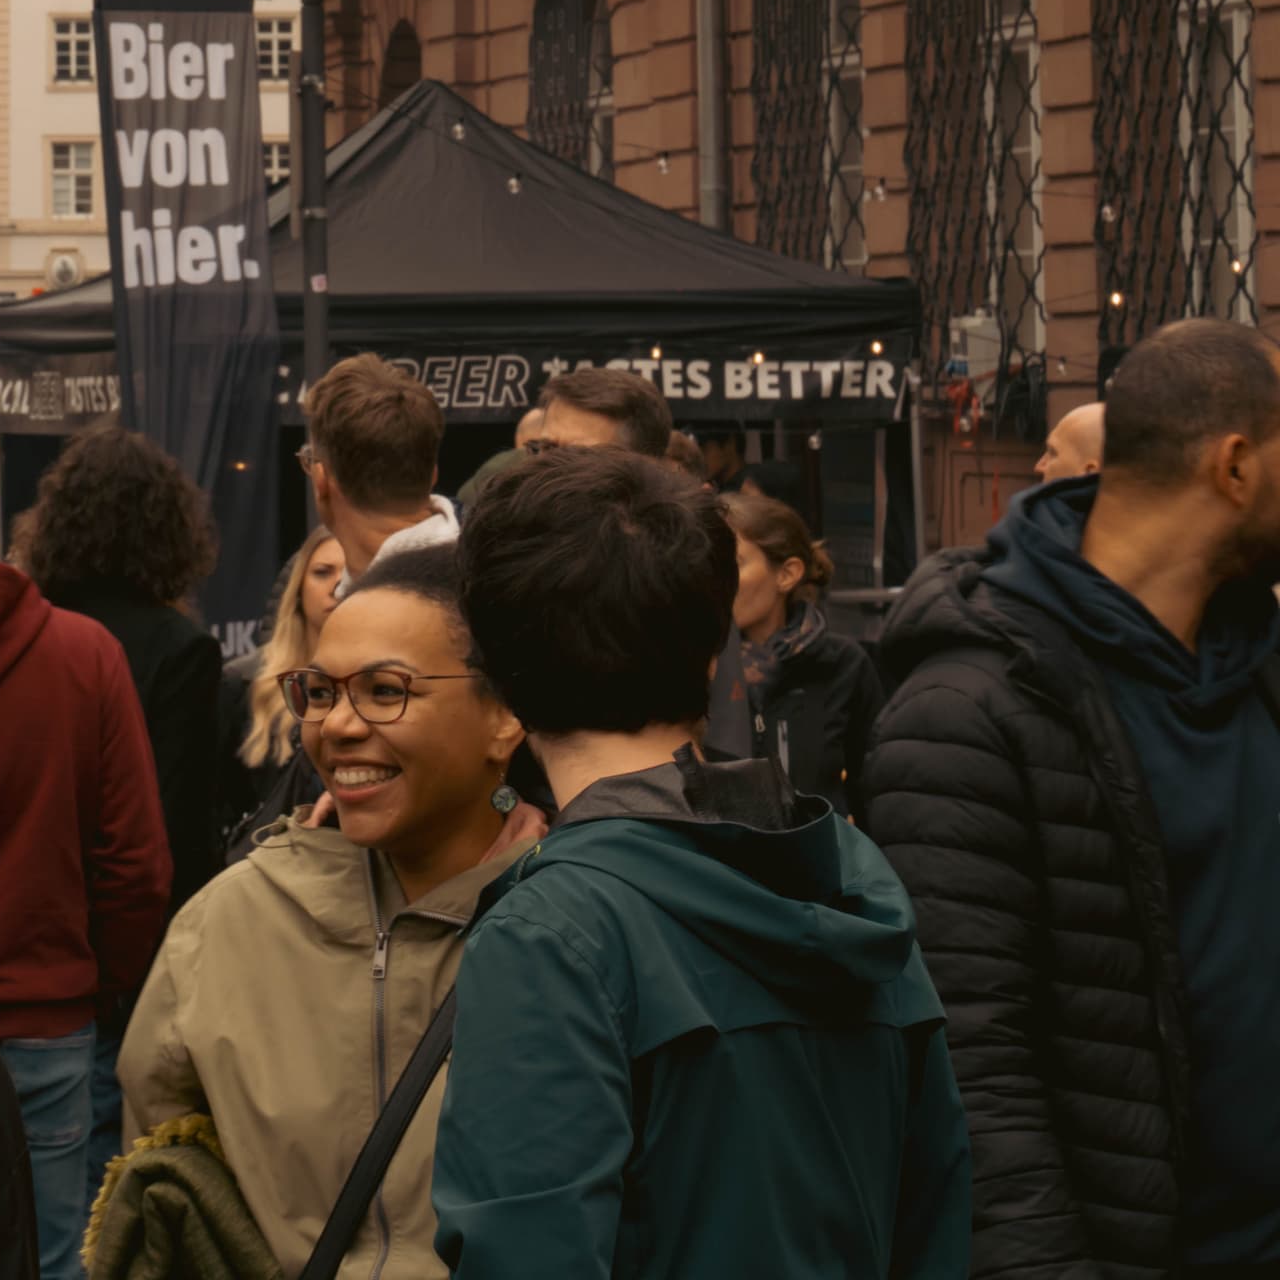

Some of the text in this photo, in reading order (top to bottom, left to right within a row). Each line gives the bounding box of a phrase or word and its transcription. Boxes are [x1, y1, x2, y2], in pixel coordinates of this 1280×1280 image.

[109, 22, 235, 100] Bier
[115, 127, 230, 188] von
[121, 208, 260, 289] hier.
[724, 359, 896, 401] BETTER
